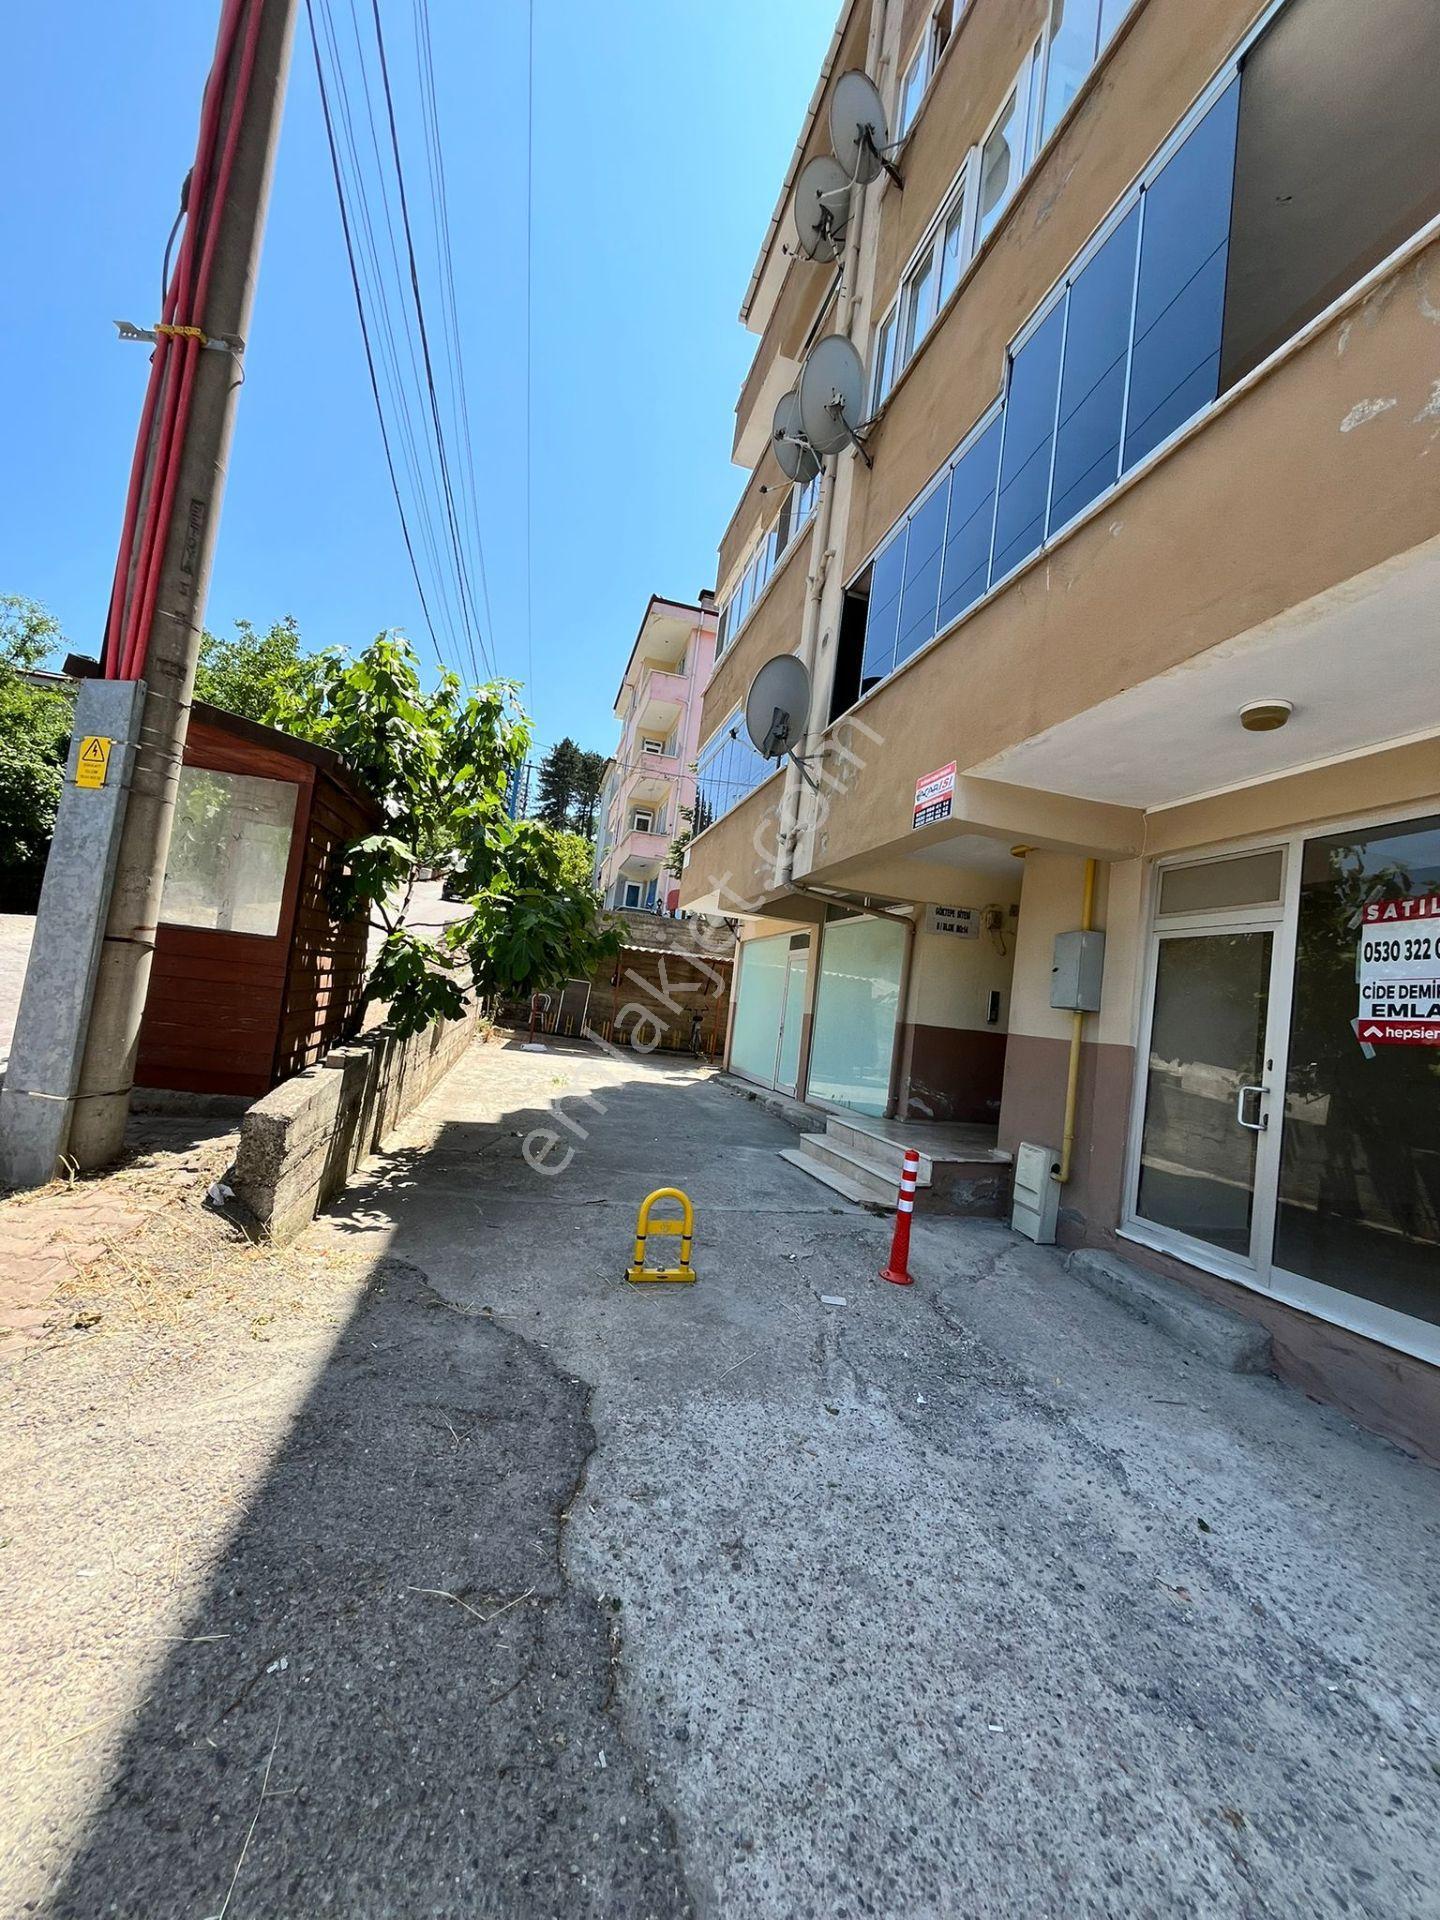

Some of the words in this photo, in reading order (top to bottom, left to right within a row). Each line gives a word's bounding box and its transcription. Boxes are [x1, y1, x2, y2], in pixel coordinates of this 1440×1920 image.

[1364, 940, 1400, 962] 0530
[1404, 937, 1431, 961] 322
[1362, 982, 1396, 999] CİDE
[1371, 1003, 1440, 1018] EMLA
